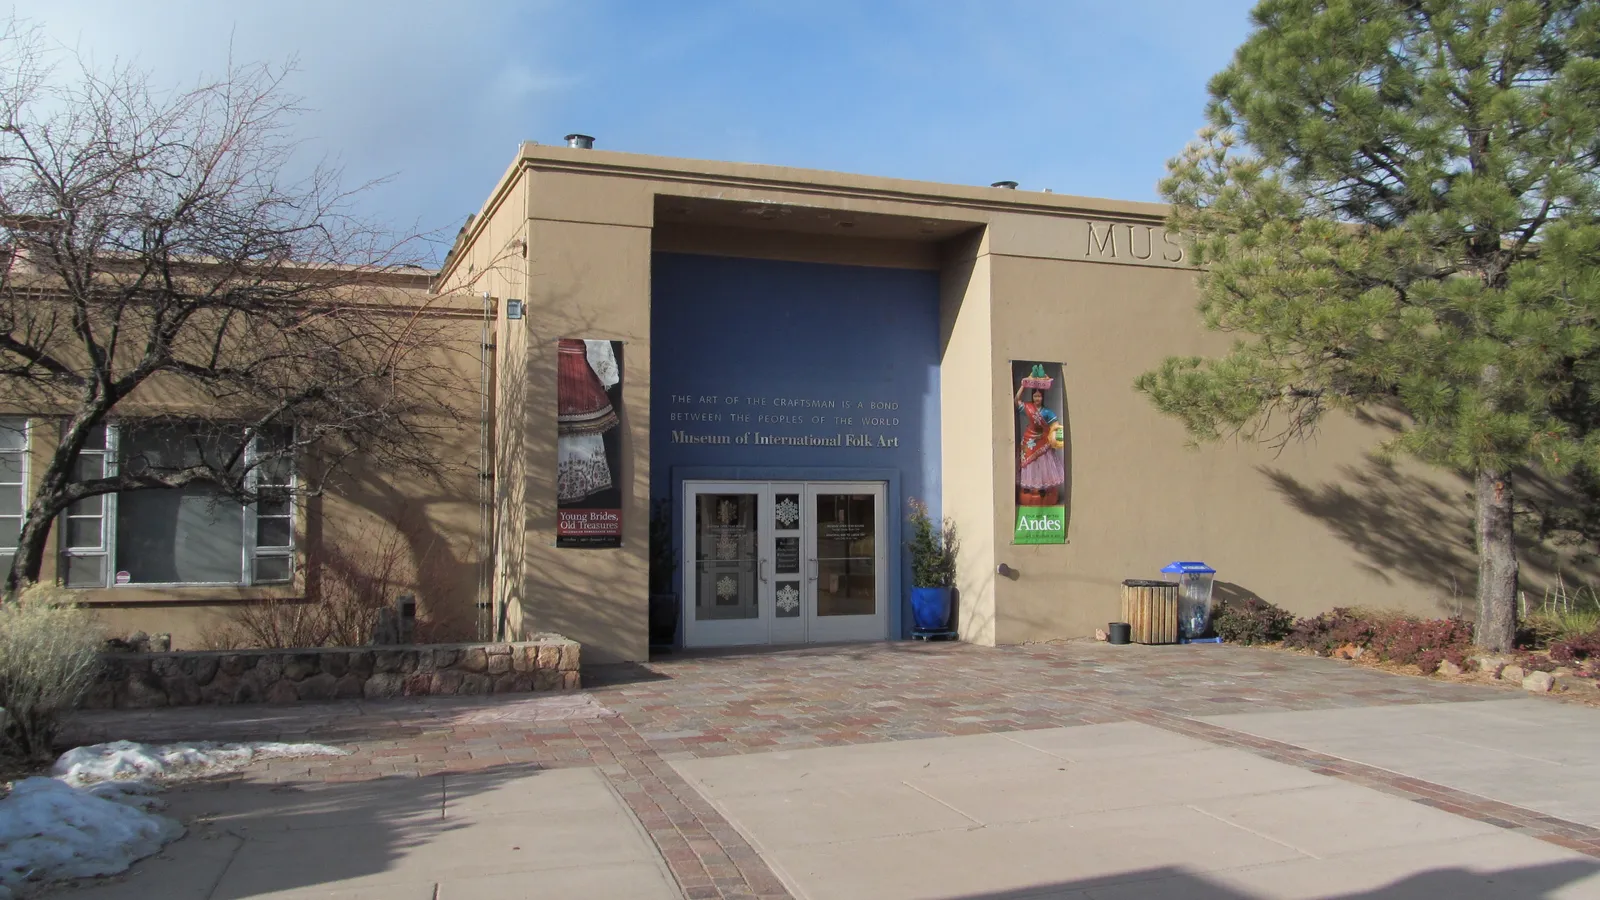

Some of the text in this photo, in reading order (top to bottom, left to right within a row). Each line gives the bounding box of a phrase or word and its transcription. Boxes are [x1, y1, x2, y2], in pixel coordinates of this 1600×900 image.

[1084, 221, 1212, 265] MUS
[671, 394, 899, 410] THE ART OF THE CRAFTSMAN IS A BOND
[670, 412, 900, 426] BETWEEN THE PEOPLES OF THE WORLD
[671, 430, 899, 447] Museum of International Folk Art
[560, 511, 619, 523] Young Brides,
[560, 520, 618, 530] Old Treasures
[1017, 515, 1061, 531] Andes
